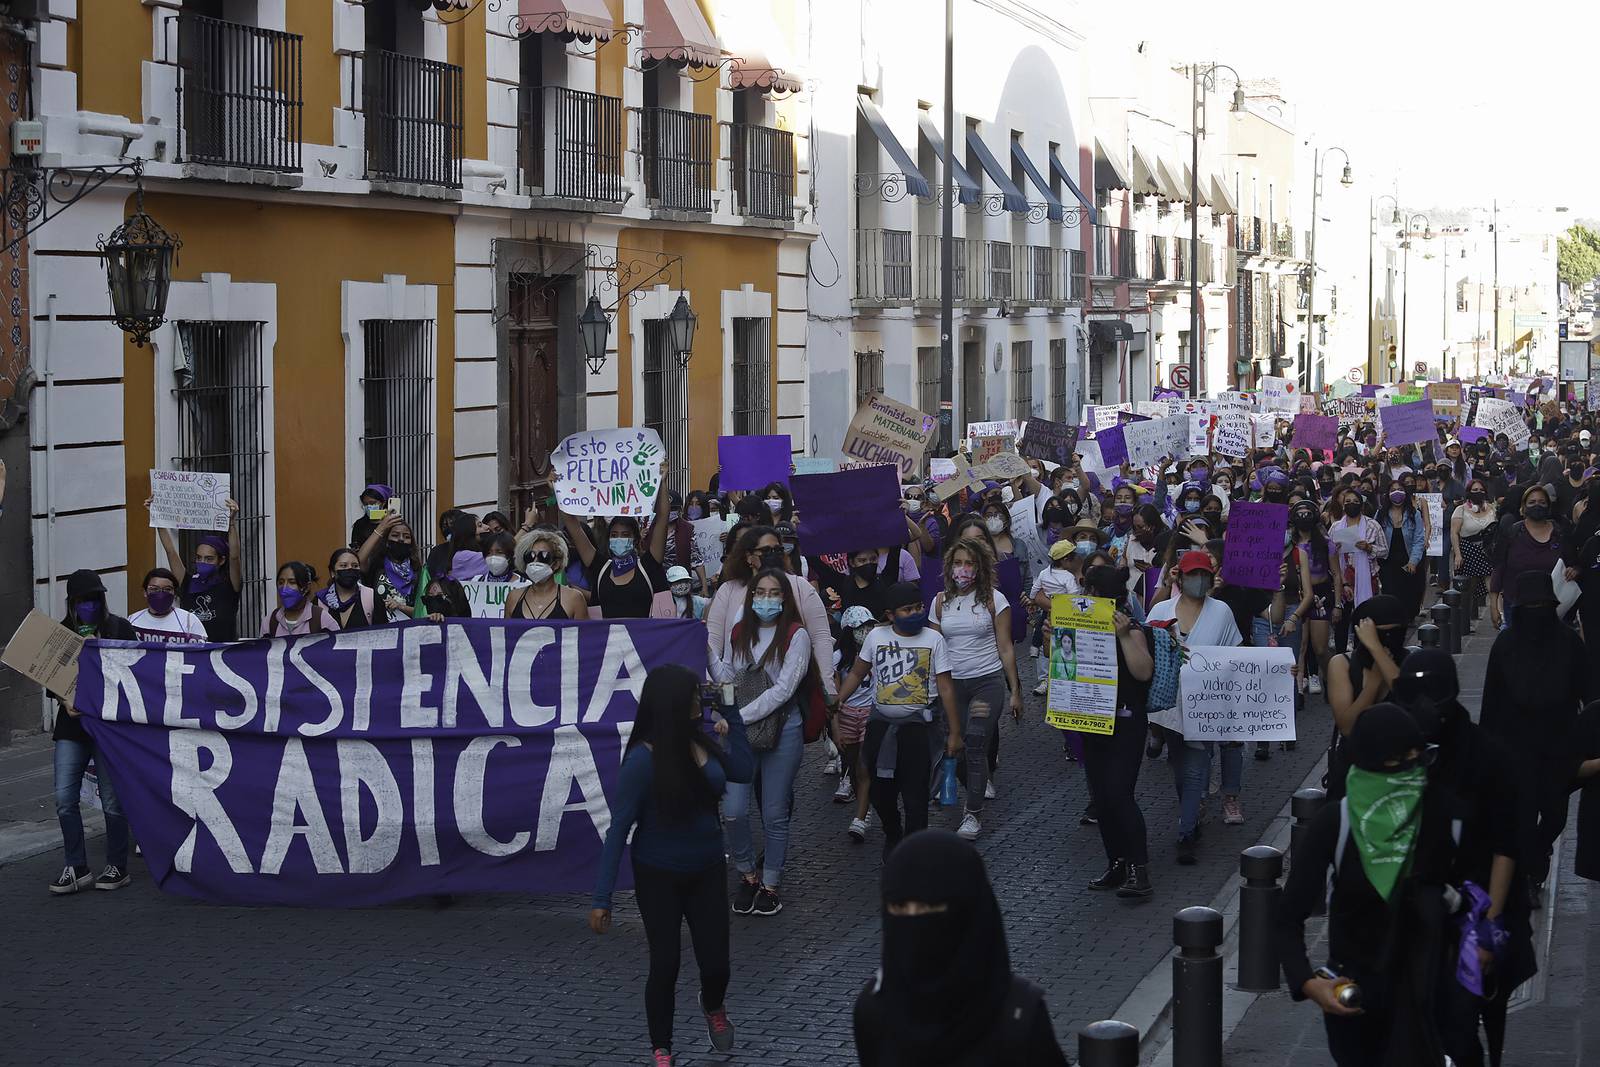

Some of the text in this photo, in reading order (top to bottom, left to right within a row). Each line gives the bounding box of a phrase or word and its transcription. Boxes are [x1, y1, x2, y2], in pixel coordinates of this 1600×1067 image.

[869, 397, 916, 426] Feministas
[873, 414, 927, 444] MATERNANDO
[566, 436, 634, 457] Esto es
[850, 437, 913, 474] LUCHANDO
[567, 456, 631, 484] PELEAR
[560, 482, 639, 506] omo NIÑA
[464, 584, 512, 605] OY LUC
[1190, 652, 1222, 672] Que
[1266, 660, 1288, 674] los
[101, 624, 648, 737] RESISTENCIA
[1246, 678, 1262, 692] del
[1187, 692, 1291, 709] gobierno y NO los
[1188, 709, 1287, 723] cuerpos de mujeres
[1198, 722, 1214, 733] los
[169, 721, 640, 876] RADICA
